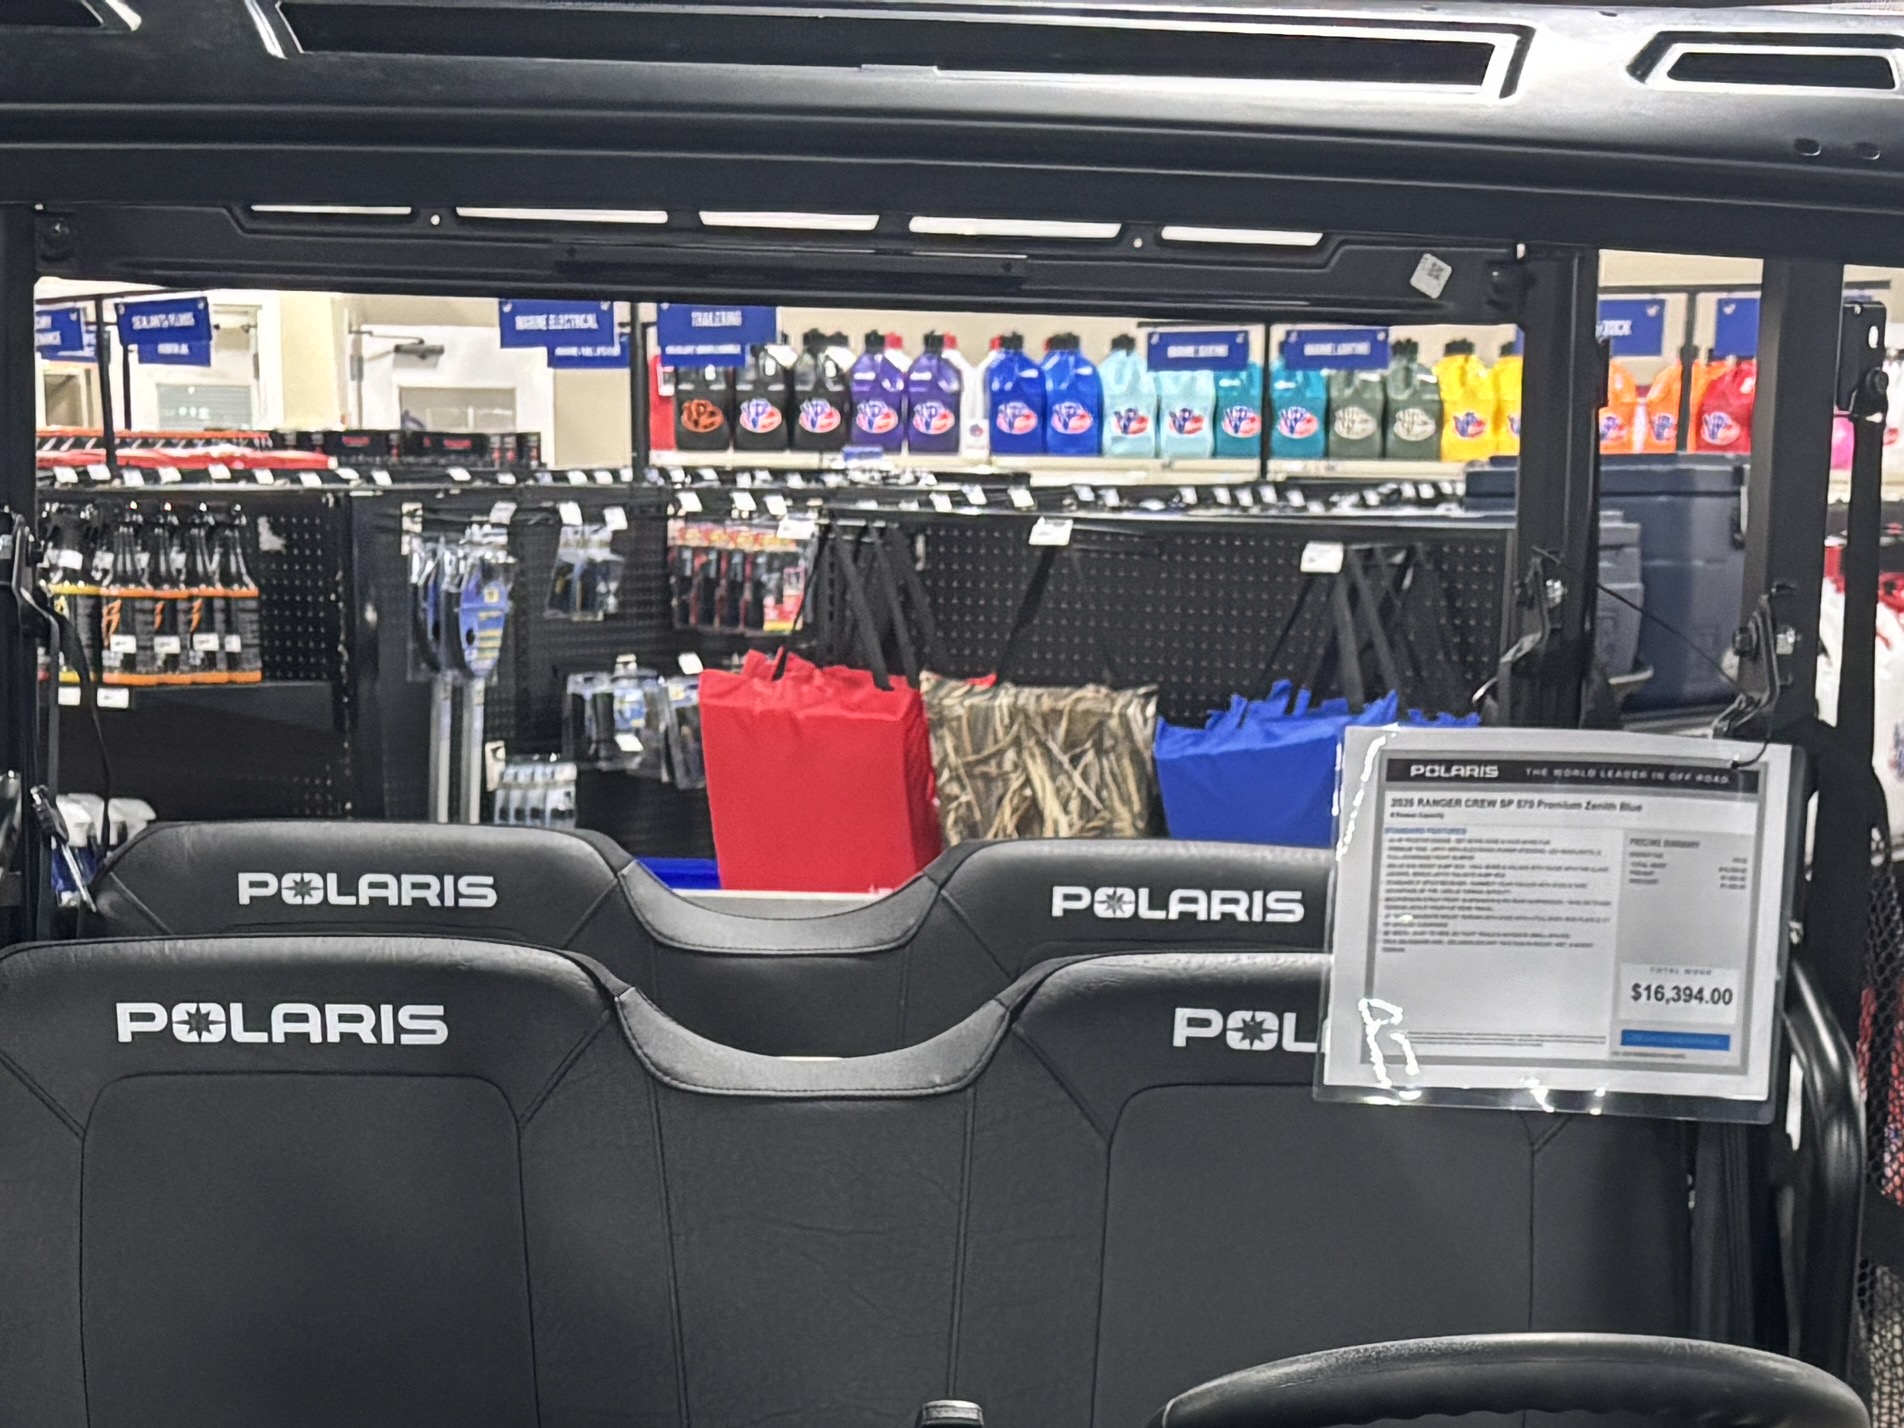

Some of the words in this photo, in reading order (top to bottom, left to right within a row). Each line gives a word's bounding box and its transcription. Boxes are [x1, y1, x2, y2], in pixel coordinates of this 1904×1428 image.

[1410, 764, 1500, 778] POLARIS
[1525, 768, 1548, 778] THE
[1553, 768, 1597, 778] WORLD
[1599, 769, 1648, 780] LEADER
[1417, 798, 1463, 809] RANGER
[1464, 799, 1498, 809] CREW
[1584, 801, 1618, 812] Zenith
[1620, 802, 1643, 812] Blue
[237, 872, 498, 908] POLARIS
[1051, 885, 1305, 923] POLARIS
[1630, 982, 1734, 1006] $16,394.00
[115, 1002, 449, 1045] POLARIS
